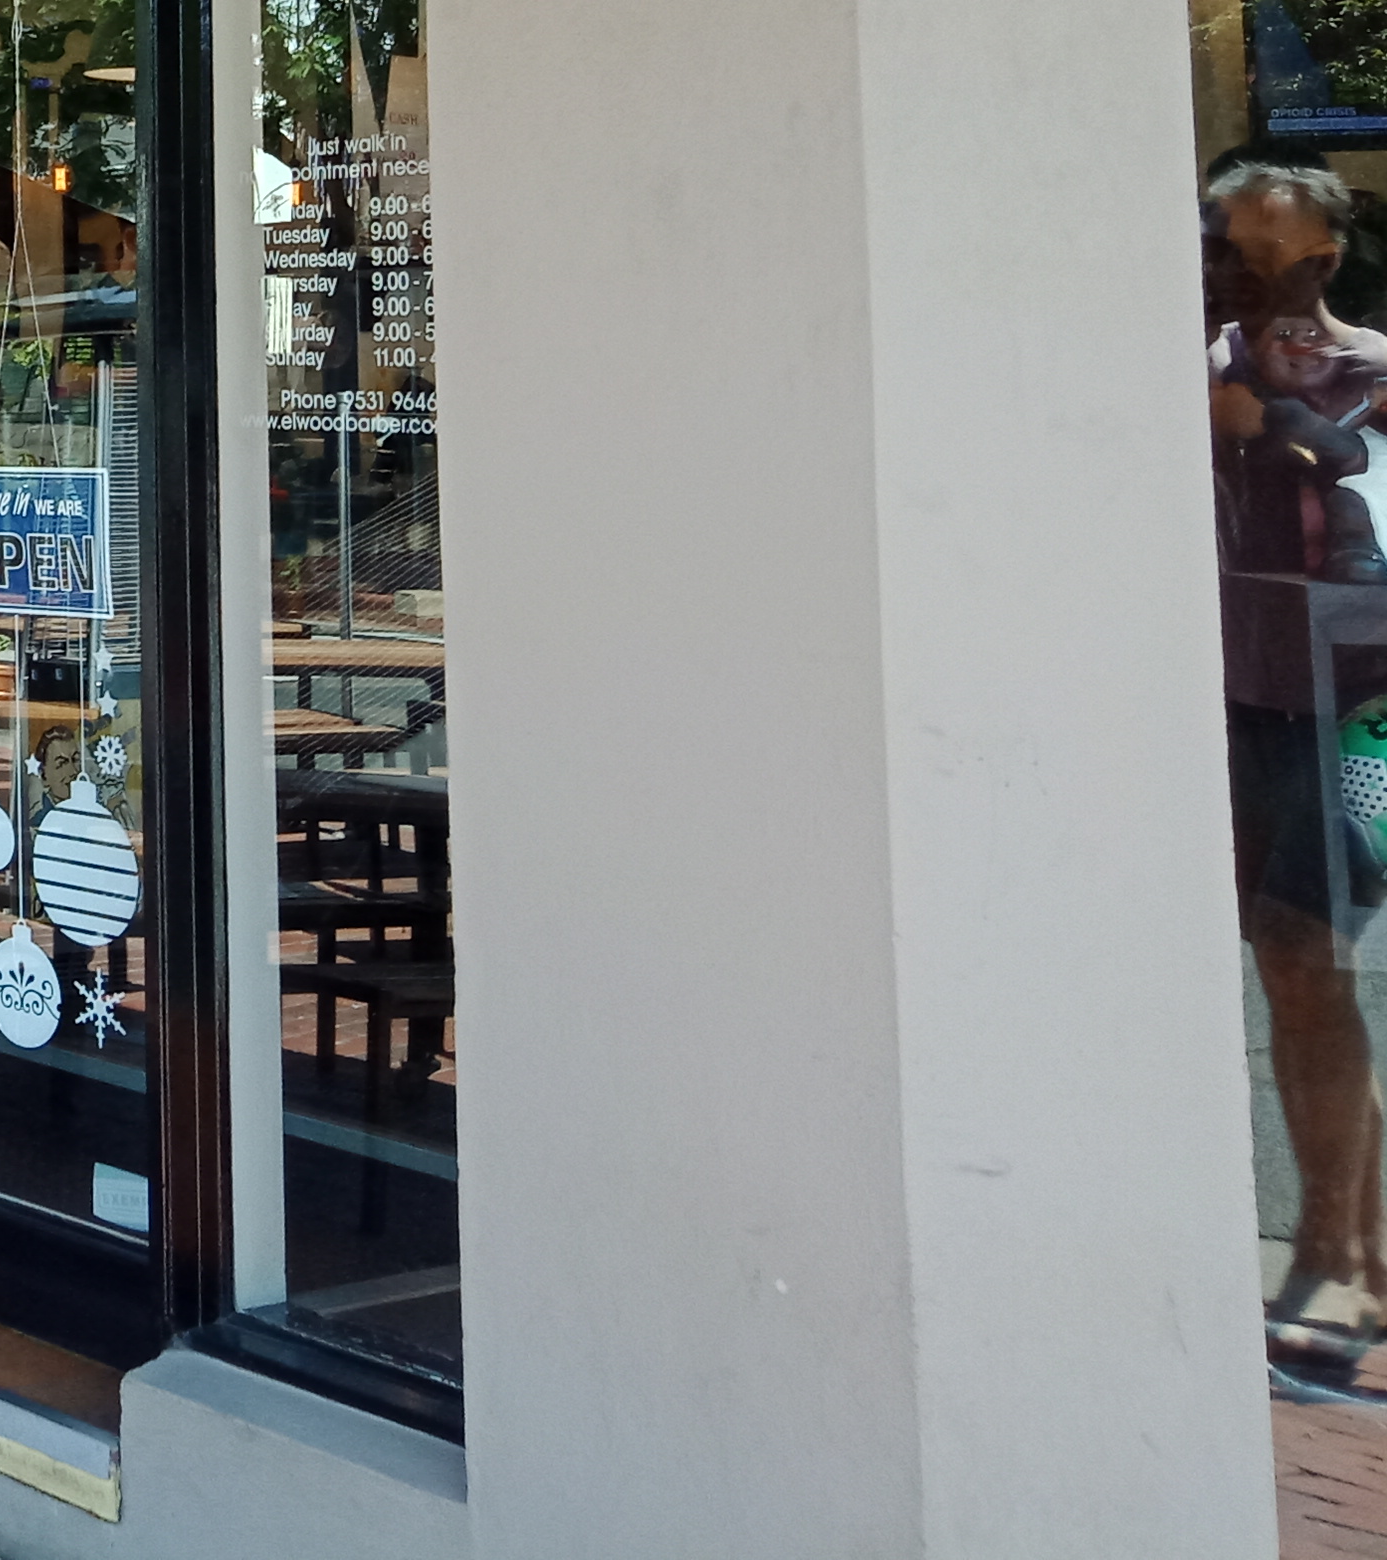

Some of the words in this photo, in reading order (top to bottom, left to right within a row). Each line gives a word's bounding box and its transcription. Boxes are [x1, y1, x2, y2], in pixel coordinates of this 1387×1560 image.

[307, 136, 340, 156] Just
[344, 133, 386, 153] walk
[390, 132, 407, 151] in
[291, 160, 378, 182] pointment
[263, 225, 330, 247] Tuesday
[370, 222, 408, 241] 9.00
[264, 248, 357, 271] Wednesday
[371, 247, 409, 266] 9.00
[371, 272, 409, 291] 9.00
[372, 297, 411, 316] 9.00
[373, 322, 411, 342] 9.00
[265, 347, 326, 371] Sunday
[373, 347, 416, 367] 11.00
[281, 389, 337, 409] Phone
[343, 391, 384, 410] 9531
[391, 391, 437, 412] 9646
[240, 412, 437, 435] www.elwoodbarber.co
[12, 485, 32, 517] in
[34, 499, 55, 516] WE
[57, 499, 83, 516] ARE
